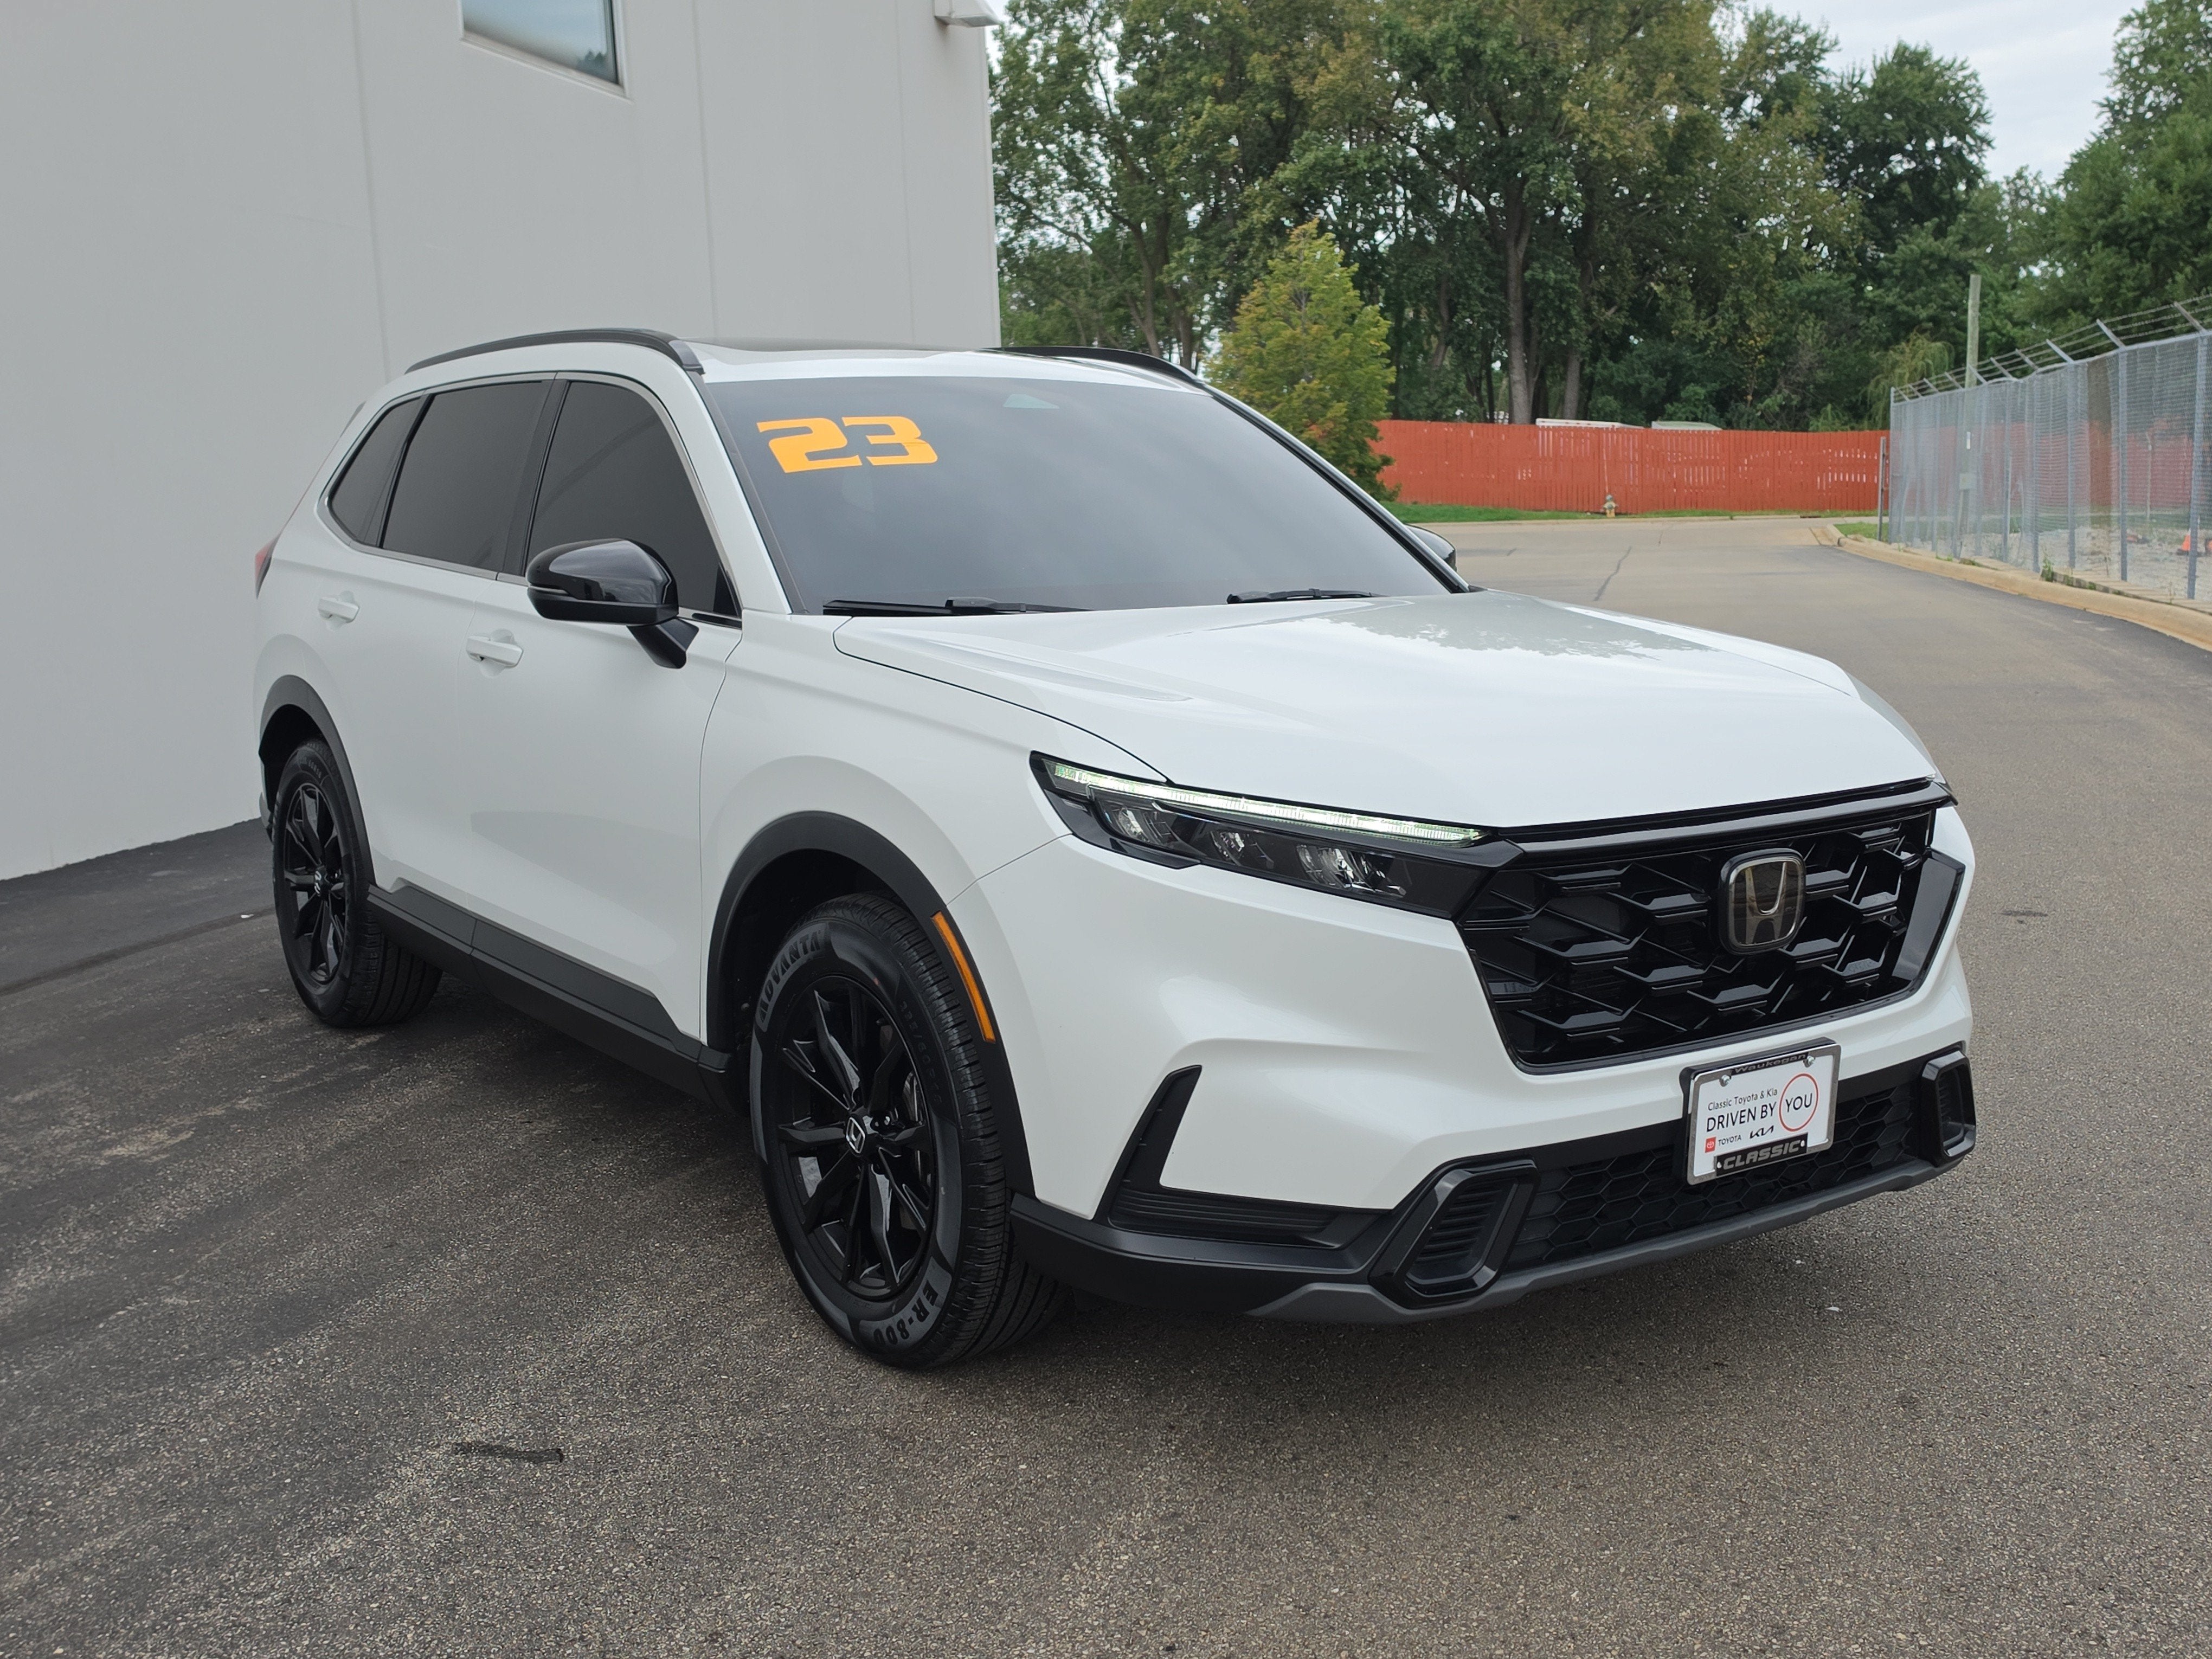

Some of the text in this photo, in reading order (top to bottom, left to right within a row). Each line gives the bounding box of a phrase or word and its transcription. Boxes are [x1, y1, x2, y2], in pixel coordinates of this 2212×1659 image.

[756, 416, 938, 473] 23
[759, 930, 821, 1023] ADVANTA
[1706, 1092, 1813, 1133] DRIVEN BY YOU
[1708, 1088, 1778, 1111] Classic Toyota & Kia
[1718, 1134, 1742, 1146] TOYOTA
[1723, 1140, 1801, 1170] CLASSIC
